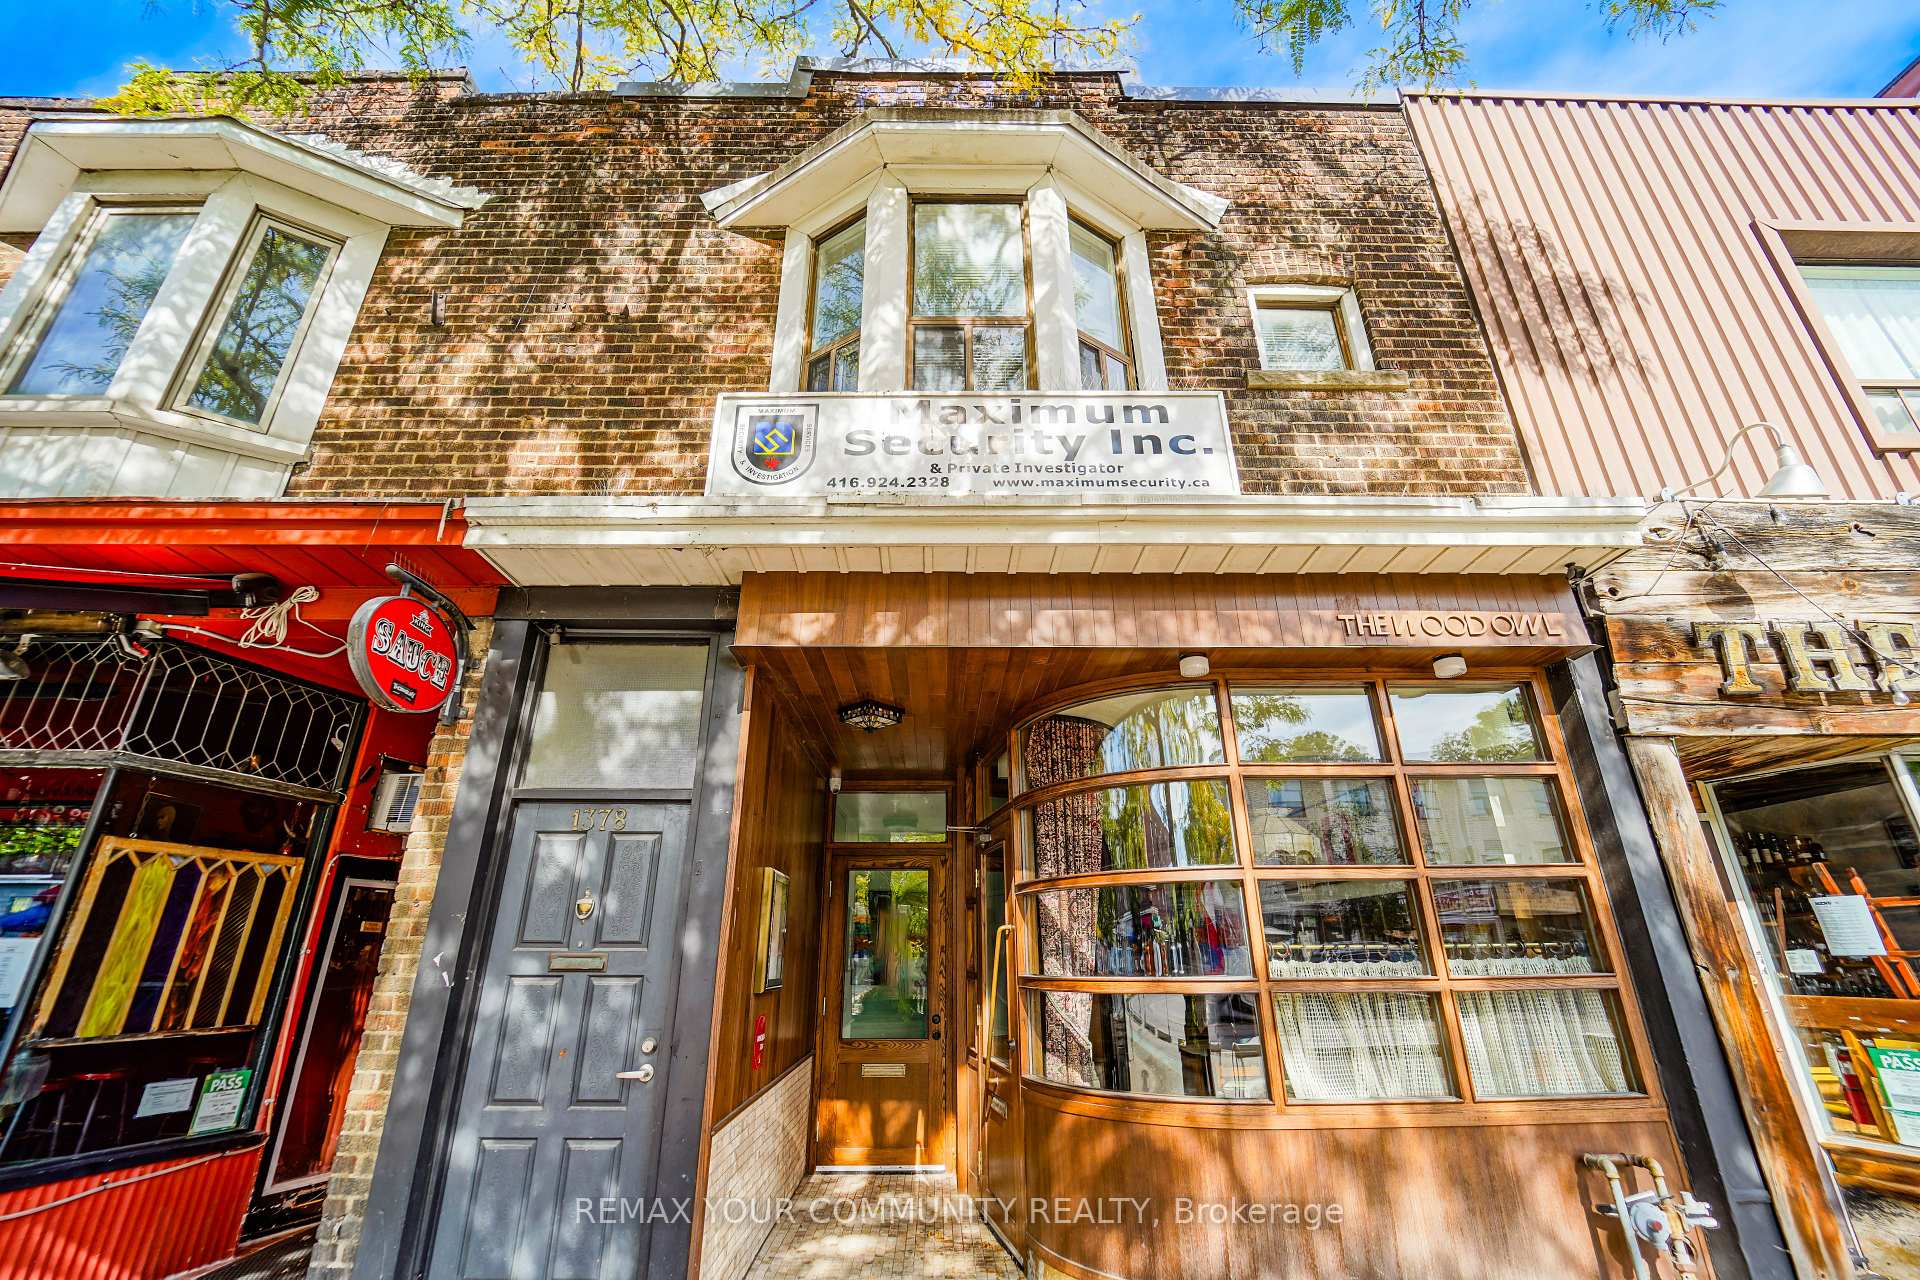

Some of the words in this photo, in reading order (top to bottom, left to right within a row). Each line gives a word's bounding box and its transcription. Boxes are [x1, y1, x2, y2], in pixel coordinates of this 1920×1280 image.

[890, 398, 1170, 425] Maximum
[844, 428, 1086, 462] Security
[1110, 429, 1214, 456] Inc.
[745, 465, 800, 481] INVESTIGATION
[930, 463, 942, 475] &
[947, 463, 1010, 474] Private
[1014, 463, 1125, 476] Investigator
[826, 476, 950, 488] 416.924.2328
[993, 477, 1210, 490] www.maximumsecurity.ca
[1337, 613, 1391, 636] THE
[1391, 614, 1488, 637] WOOD
[1491, 613, 1562, 637] OWL
[371, 618, 452, 692] SAUCE
[571, 808, 627, 831] 1378
[210, 1076, 243, 1092] PASS
